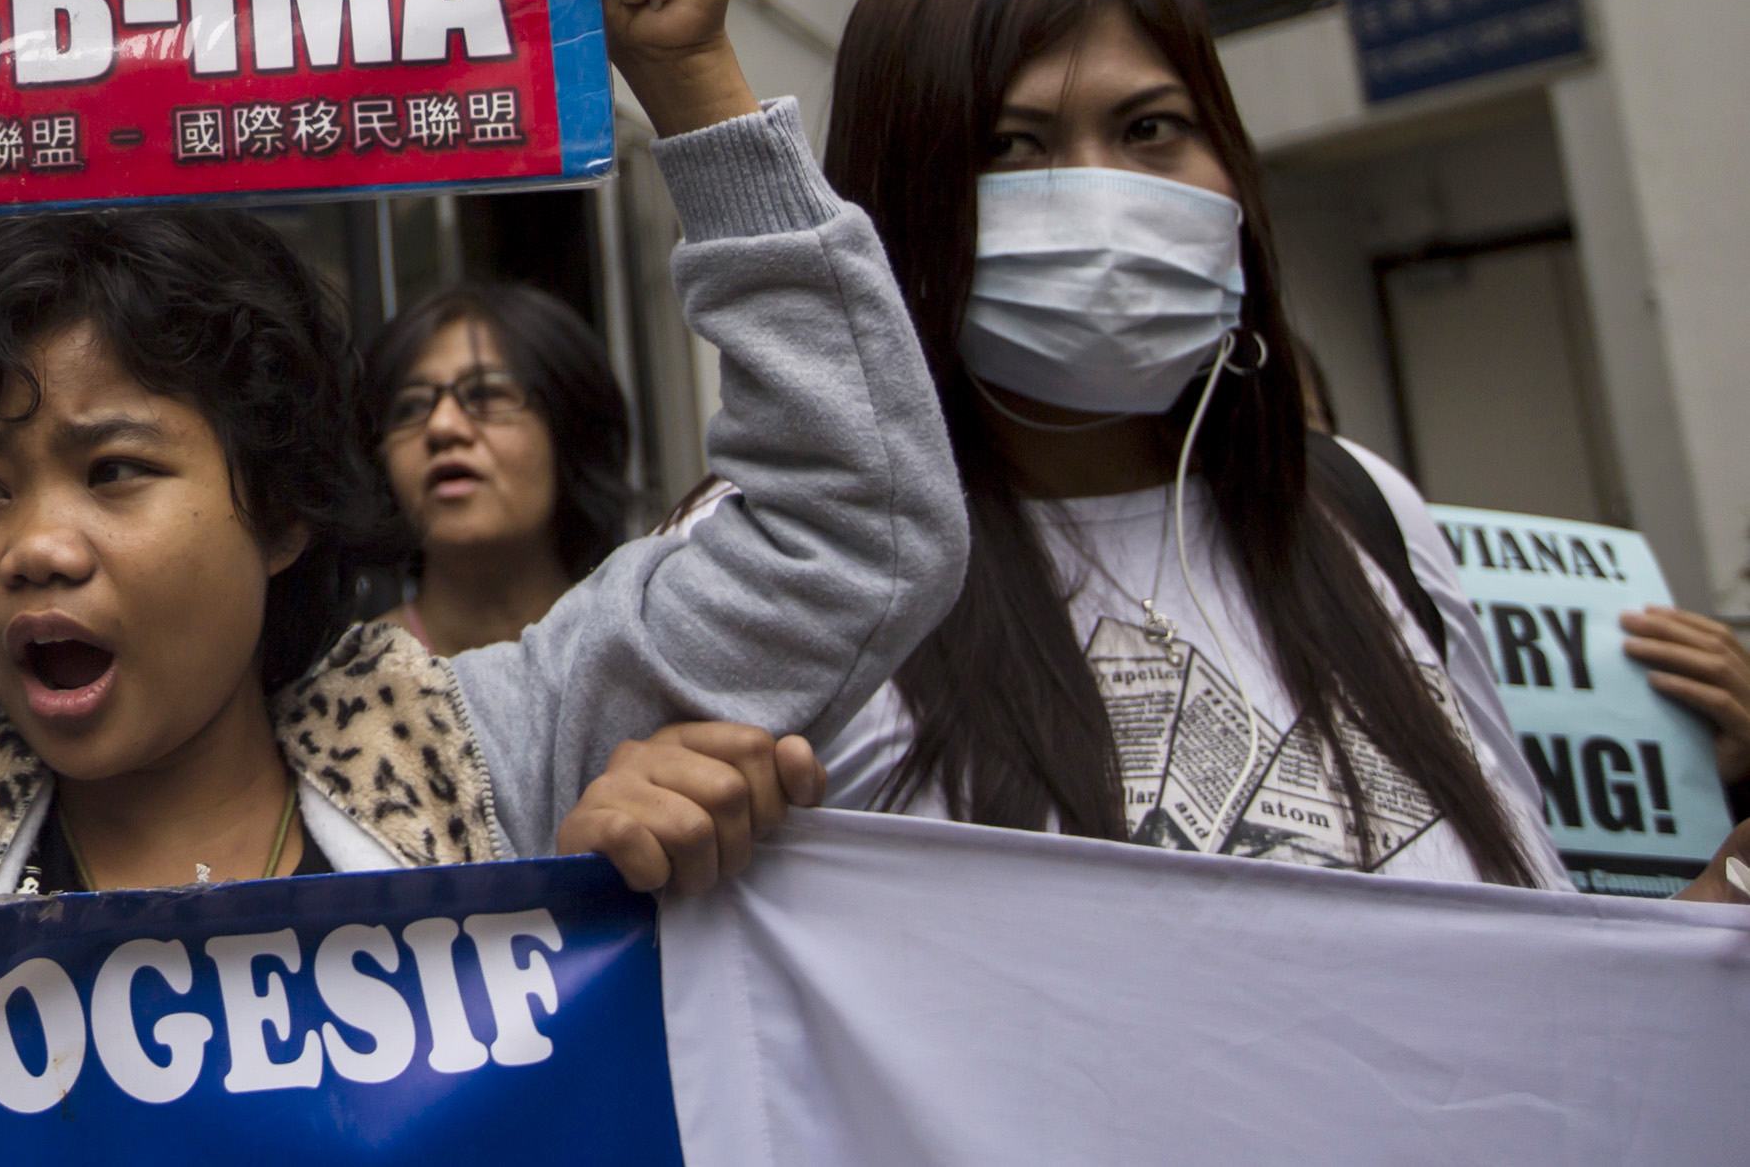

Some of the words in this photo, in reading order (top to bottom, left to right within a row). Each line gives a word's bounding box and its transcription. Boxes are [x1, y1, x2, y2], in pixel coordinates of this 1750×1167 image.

[174, 90, 523, 159] 國際移民聯盟
[1474, 600, 1594, 691] RY
[1260, 800, 1331, 828] atom
